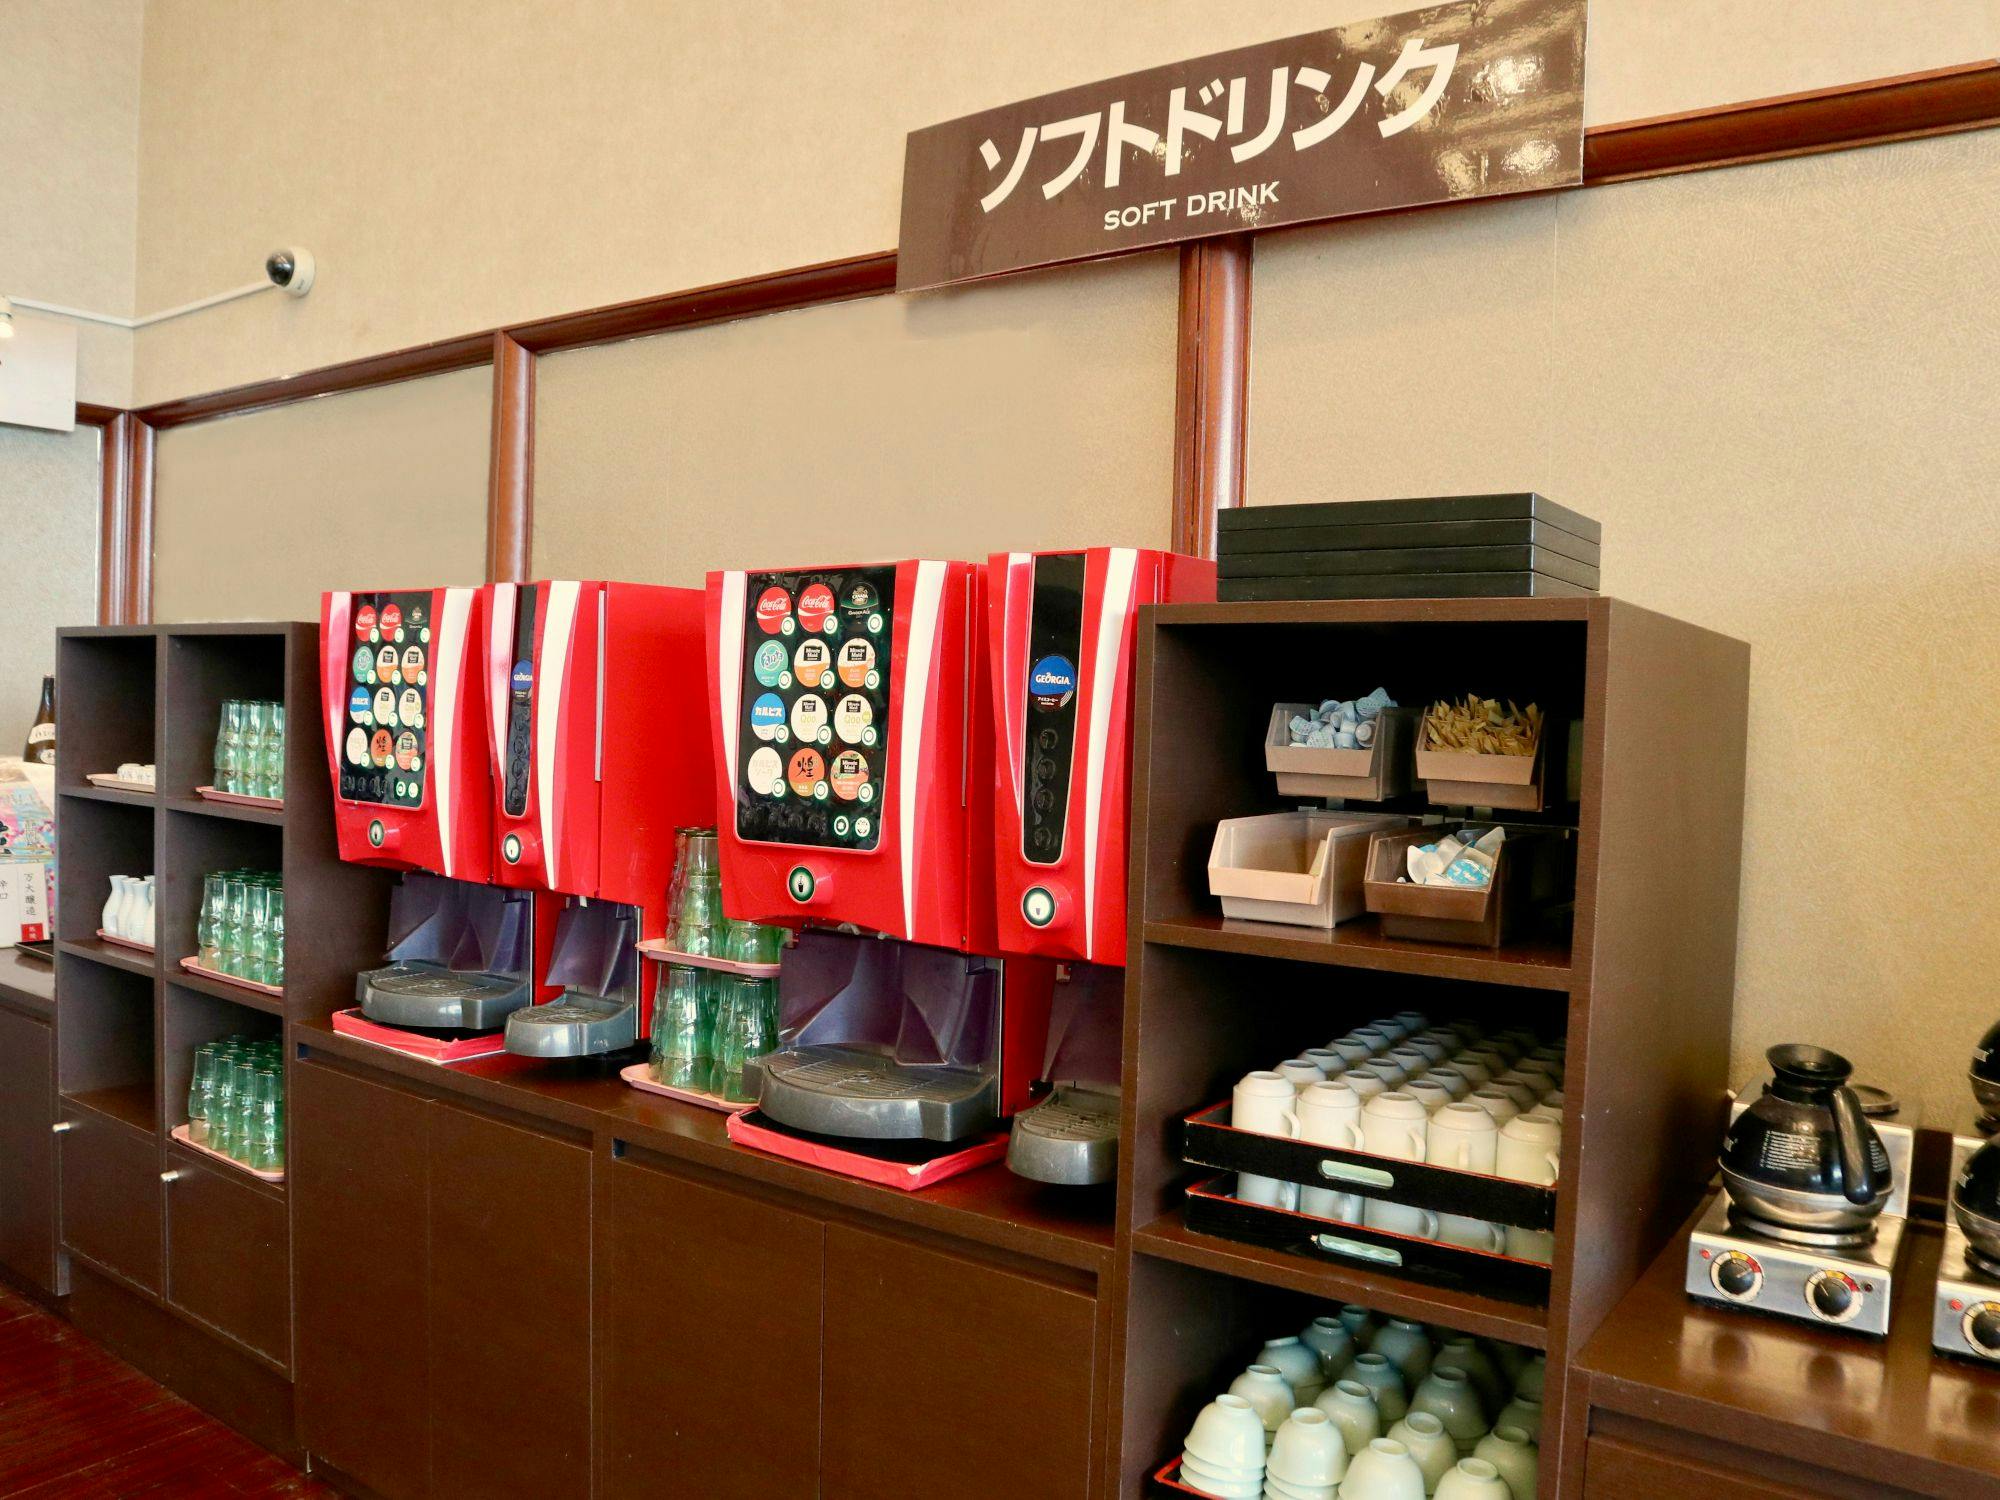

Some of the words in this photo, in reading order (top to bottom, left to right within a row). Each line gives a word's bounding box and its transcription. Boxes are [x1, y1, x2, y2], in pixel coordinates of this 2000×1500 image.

[978, 38, 1460, 213] ソフトドリンク
[1103, 199, 1177, 231] SOFT
[1185, 180, 1280, 217] DRINK
[1035, 672, 1071, 685] GEORGIA
[755, 706, 782, 717] カルピス
